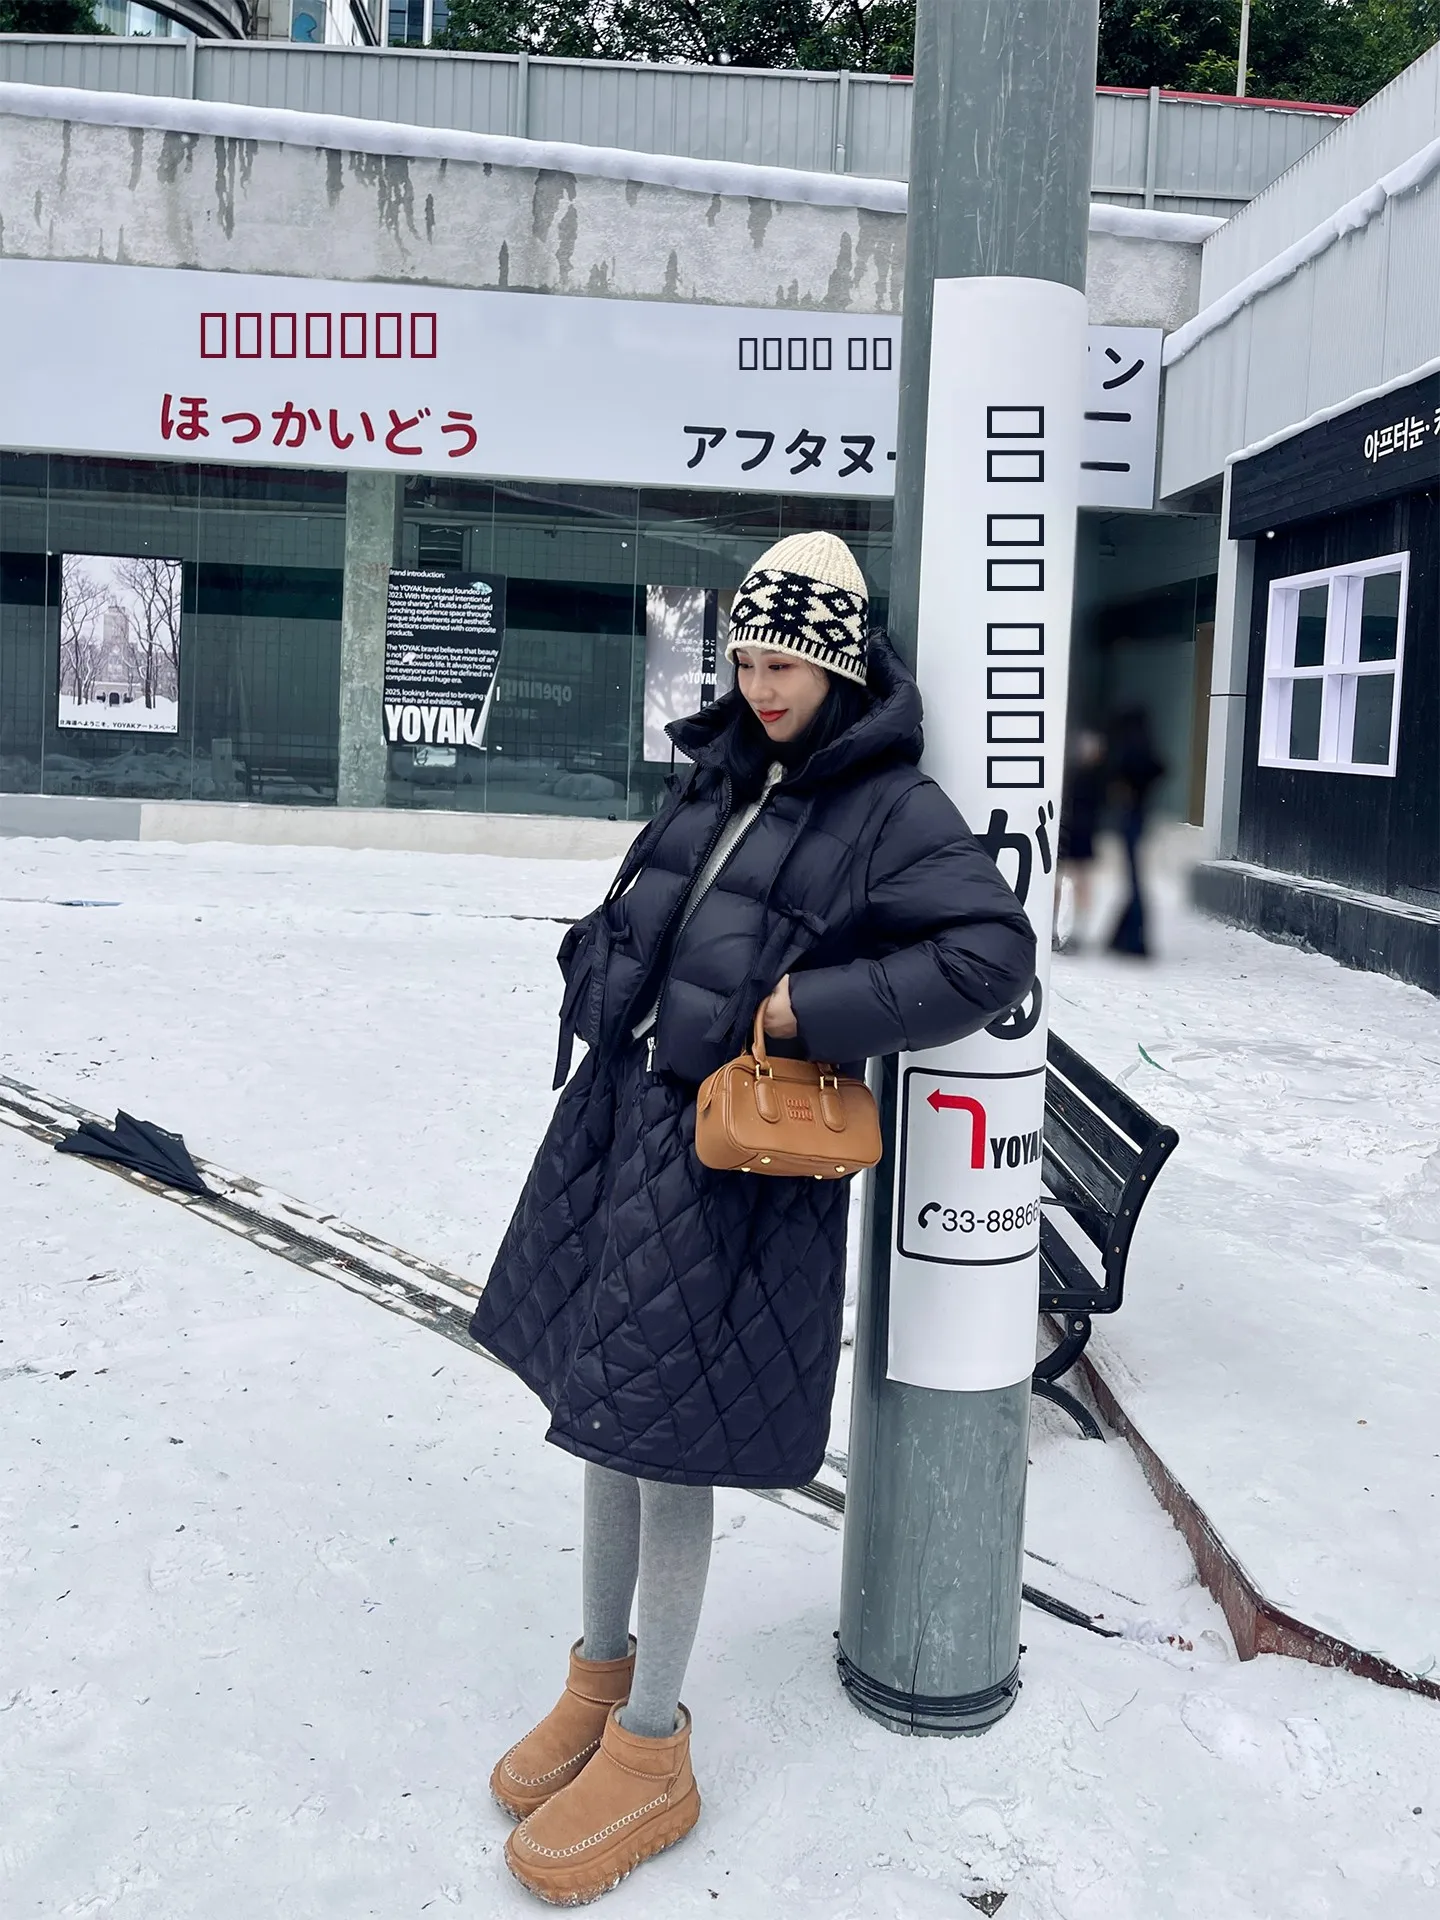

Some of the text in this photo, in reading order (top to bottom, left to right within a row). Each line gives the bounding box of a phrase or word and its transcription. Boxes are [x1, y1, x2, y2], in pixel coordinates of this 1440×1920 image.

[1088, 346, 1145, 390] ン
[160, 392, 478, 458] ほっかいどう
[683, 424, 897, 478] アフタヌ
[407, 570, 446, 579] introduction:
[388, 583, 400, 591] The
[400, 584, 422, 592] YOYAK
[422, 585, 441, 593] brand
[404, 592, 420, 600] With
[431, 594, 454, 603] original
[454, 595, 483, 603] intention
[483, 596, 491, 604] of
[439, 601, 457, 609] builds
[462, 602, 494, 611] diversified
[387, 607, 416, 616] punching
[466, 610, 492, 619] through
[387, 615, 408, 623] unique
[422, 616, 450, 624] elements
[463, 618, 491, 626] aesthetic
[386, 621, 497, 634] predictions combined with composite
[386, 629, 414, 637] products.
[387, 643, 499, 658] The YOYAK brand believes that beauty
[431, 654, 450, 662] vision,
[386, 666, 399, 674] that
[398, 668, 427, 676] everyone
[450, 669, 458, 677] be
[458, 669, 482, 677] defined
[434, 660, 446, 668] life.
[452, 662, 472, 671] always
[472, 663, 492, 671] hopes
[385, 674, 422, 683] complicated
[434, 676, 451, 685] huge
[688, 672, 718, 685] YOYAK
[385, 688, 402, 697] 2025,
[402, 688, 426, 699] looking
[425, 690, 450, 698] forward
[450, 691, 458, 699] to
[457, 691, 484, 701] bringing
[401, 696, 416, 704] flash
[429, 698, 463, 706] exhibitions.
[384, 704, 476, 745] YOYAK
[786, 1099, 810, 1110] miu
[788, 1109, 813, 1122] miu
[941, 1198, 1041, 1234] 33-88866
